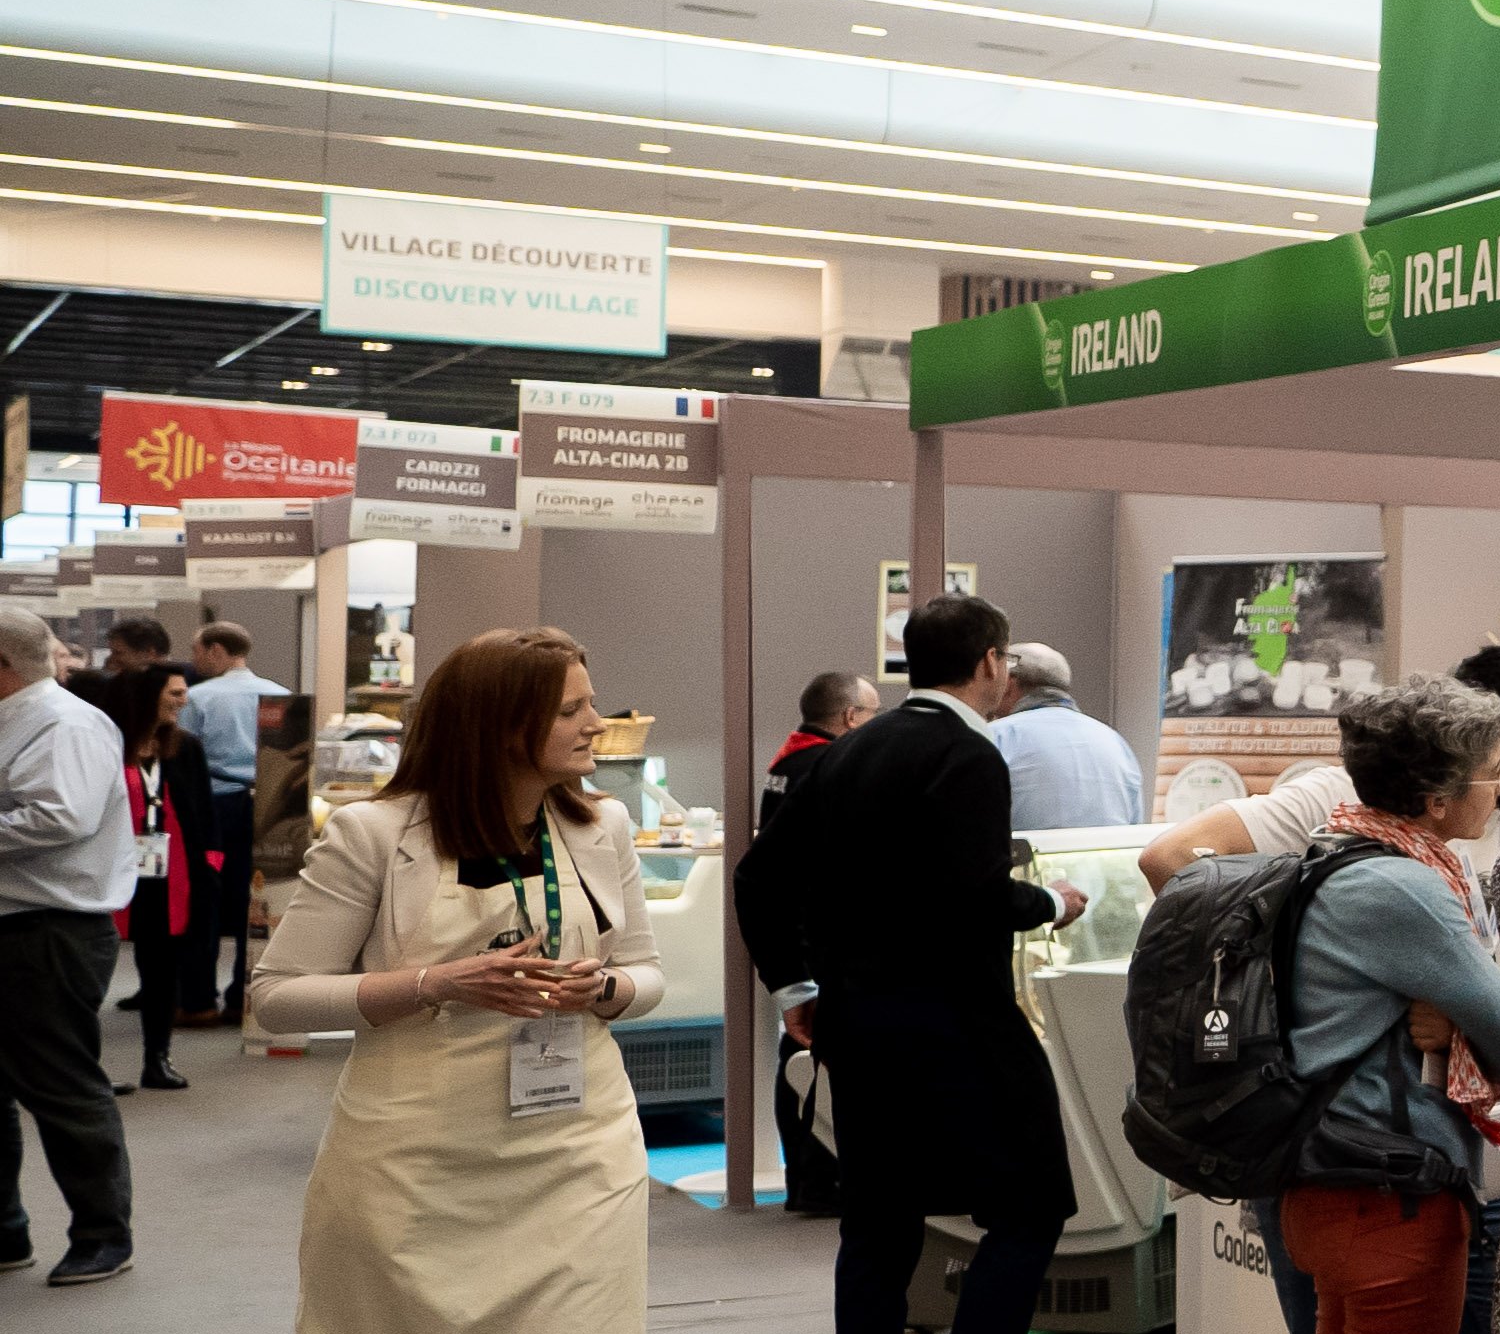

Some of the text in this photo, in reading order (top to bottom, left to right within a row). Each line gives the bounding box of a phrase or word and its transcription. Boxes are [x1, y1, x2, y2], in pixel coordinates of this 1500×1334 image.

[342, 231, 651, 276] VILLAGE DÉCOUVERTE
[354, 276, 638, 317] DISCOVERY VILLAGE
[1071, 309, 1162, 376] IRELAND
[557, 426, 686, 450] FROMAGERIE
[405, 458, 479, 478] CAROZZI
[554, 448, 659, 470] ALTA-CIMA
[396, 476, 486, 497] FORMAGGI
[536, 491, 614, 509] fromage
